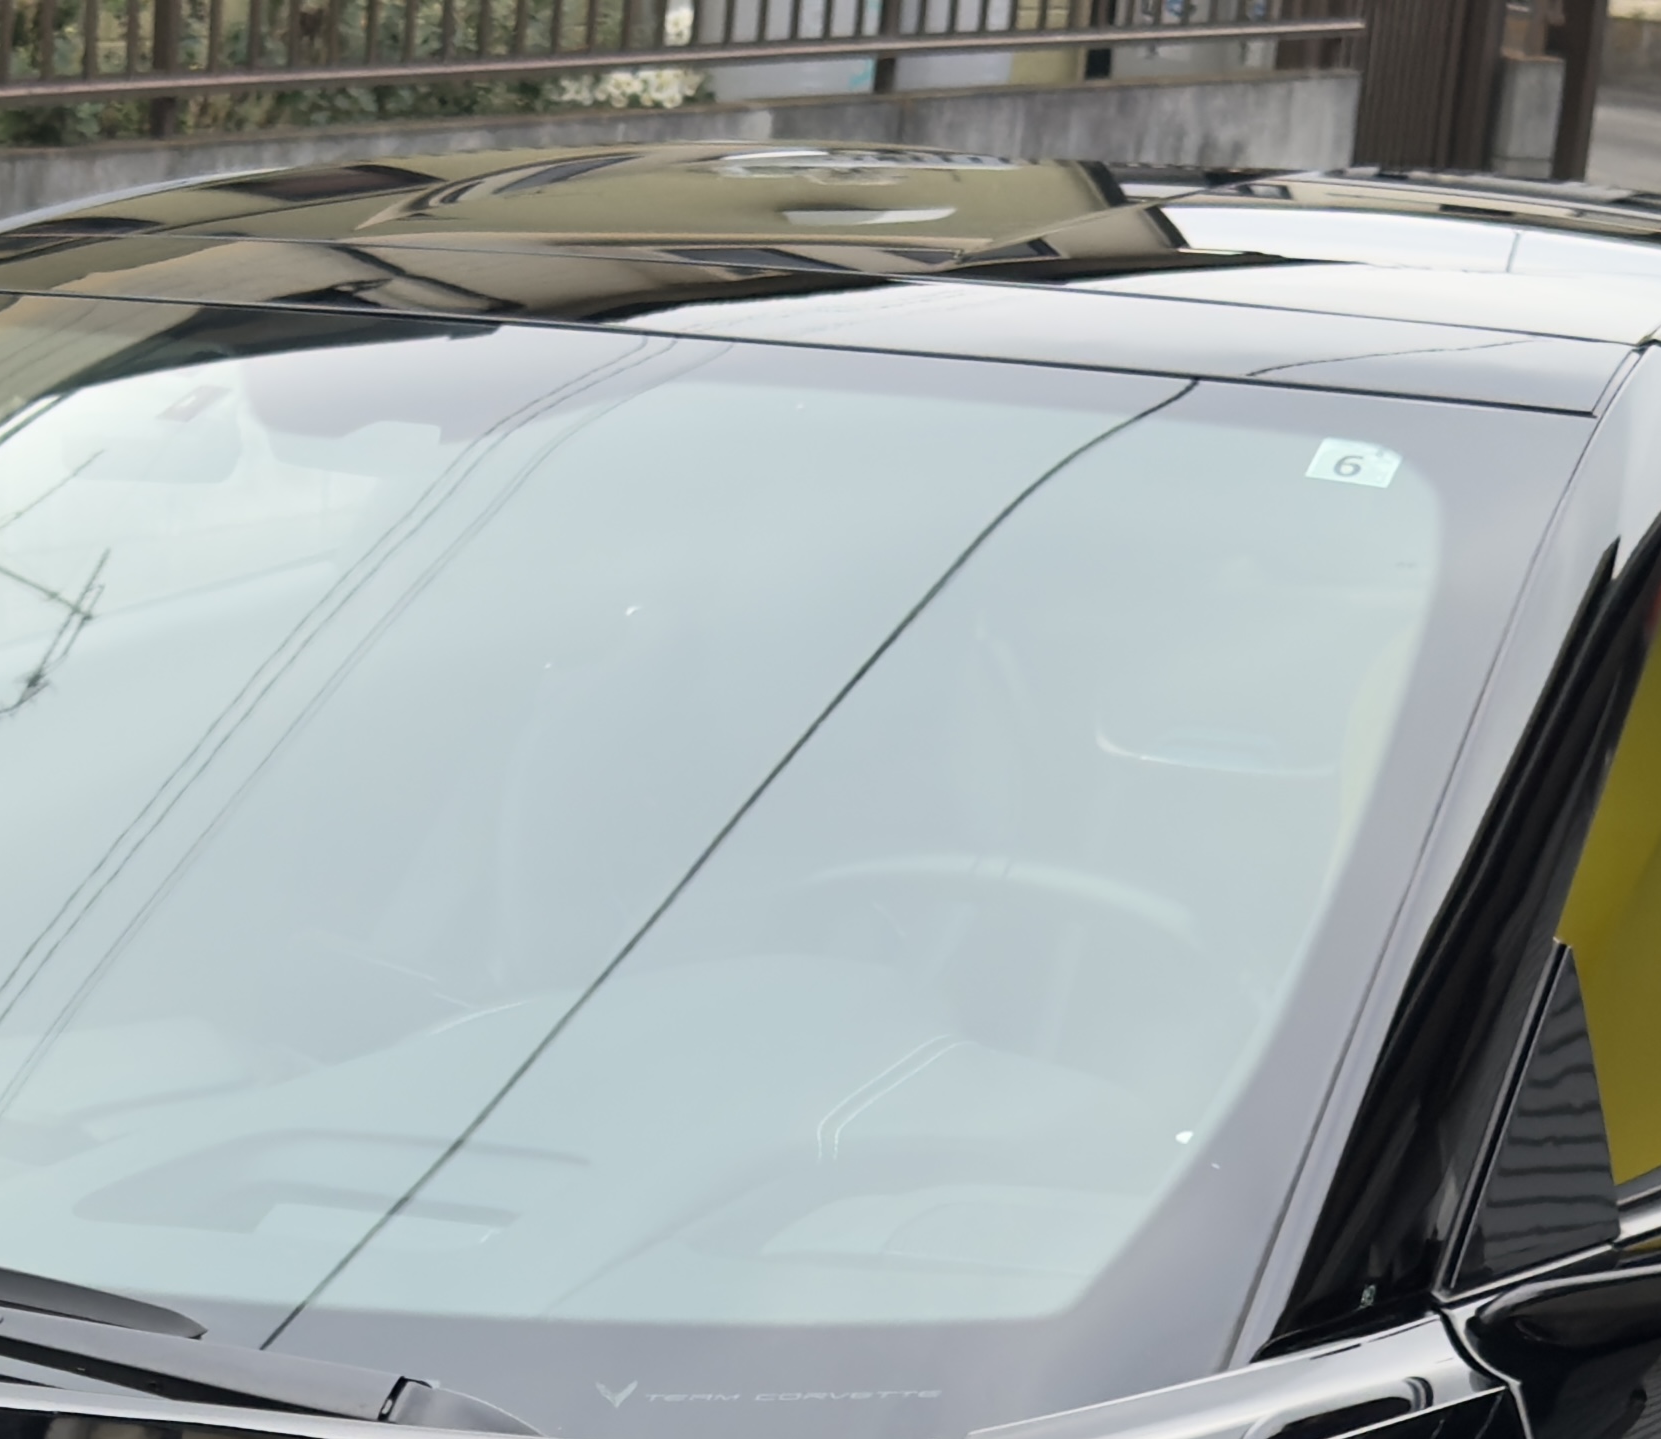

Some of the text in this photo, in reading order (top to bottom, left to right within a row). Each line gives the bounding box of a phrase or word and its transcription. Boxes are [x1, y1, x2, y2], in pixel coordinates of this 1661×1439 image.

[1333, 454, 1364, 477] 6
[644, 1389, 942, 1402] TEAM CORVETTE
